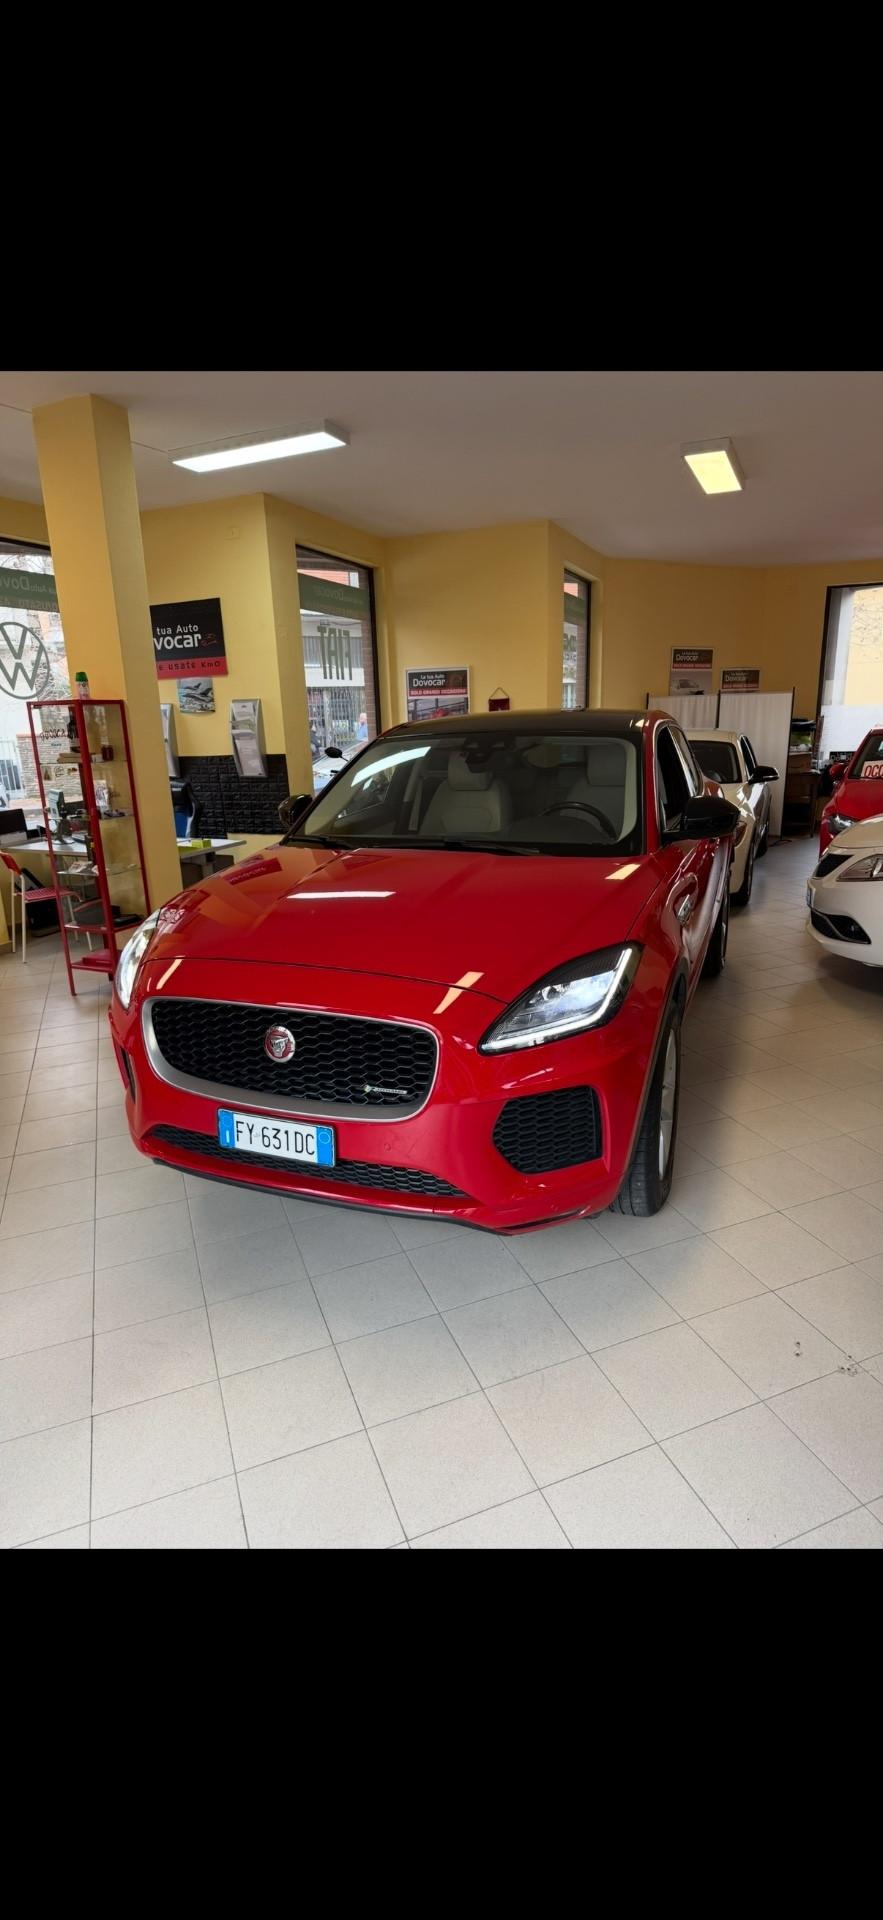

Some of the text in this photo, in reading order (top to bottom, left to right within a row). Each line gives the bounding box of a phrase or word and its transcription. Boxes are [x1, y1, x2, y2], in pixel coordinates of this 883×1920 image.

[156, 623, 199, 635] tua Auto
[412, 678, 446, 687] Dovocar
[235, 1120, 316, 1156] FY 631DC
